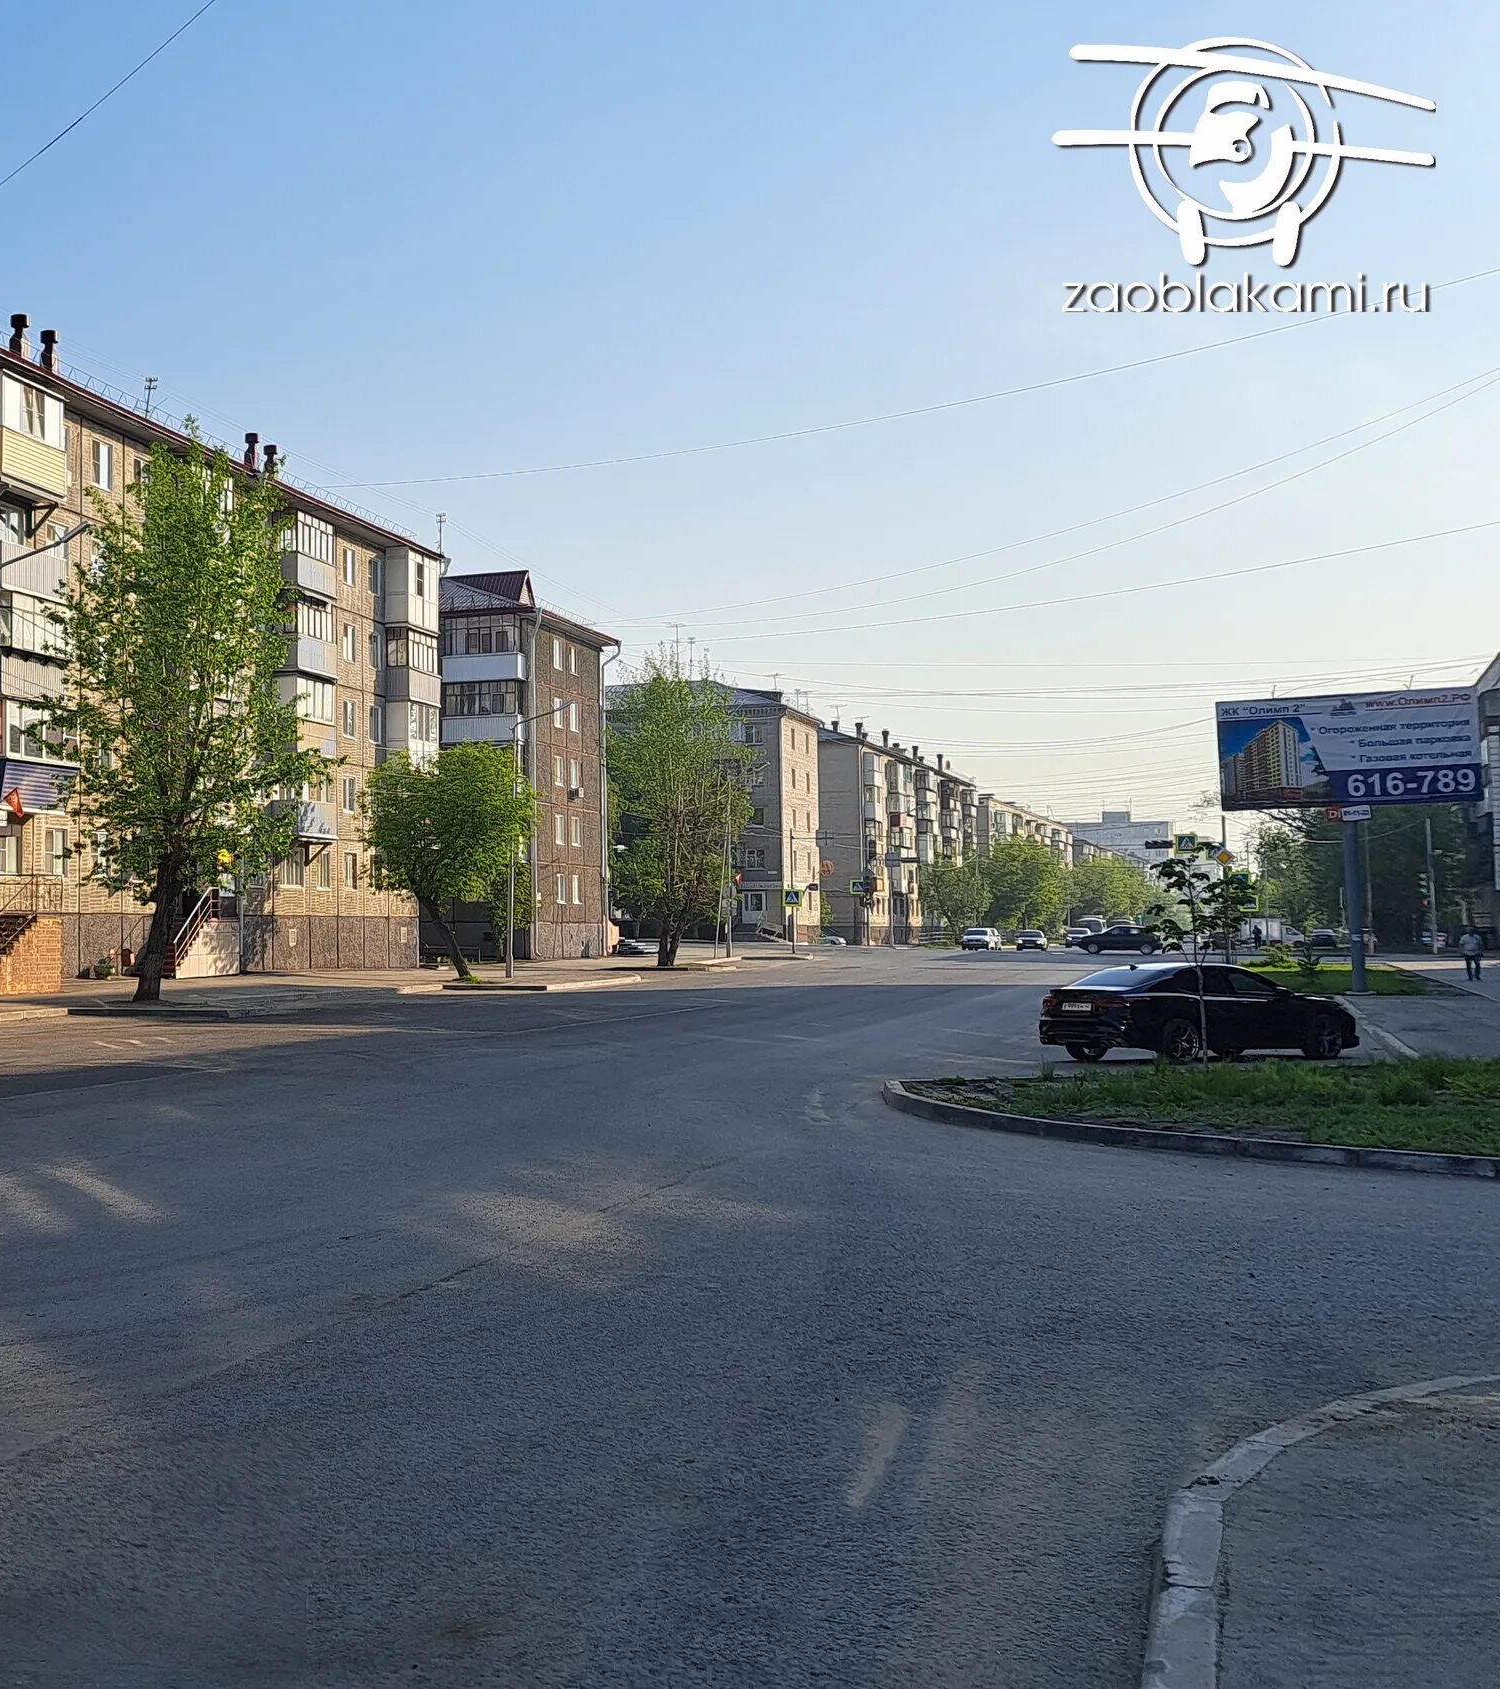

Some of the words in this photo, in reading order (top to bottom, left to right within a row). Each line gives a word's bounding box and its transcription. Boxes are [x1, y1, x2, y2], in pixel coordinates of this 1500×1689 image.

[1220, 707, 1239, 716] ЖК
[1319, 724, 1397, 735] Огороженная
[1400, 719, 1470, 731] территория
[1358, 738, 1412, 748] Большая
[1415, 734, 1471, 746] парковка
[1359, 753, 1407, 763] Газовая
[1409, 749, 1472, 760] котельная
[1347, 768, 1476, 797] 616-789
